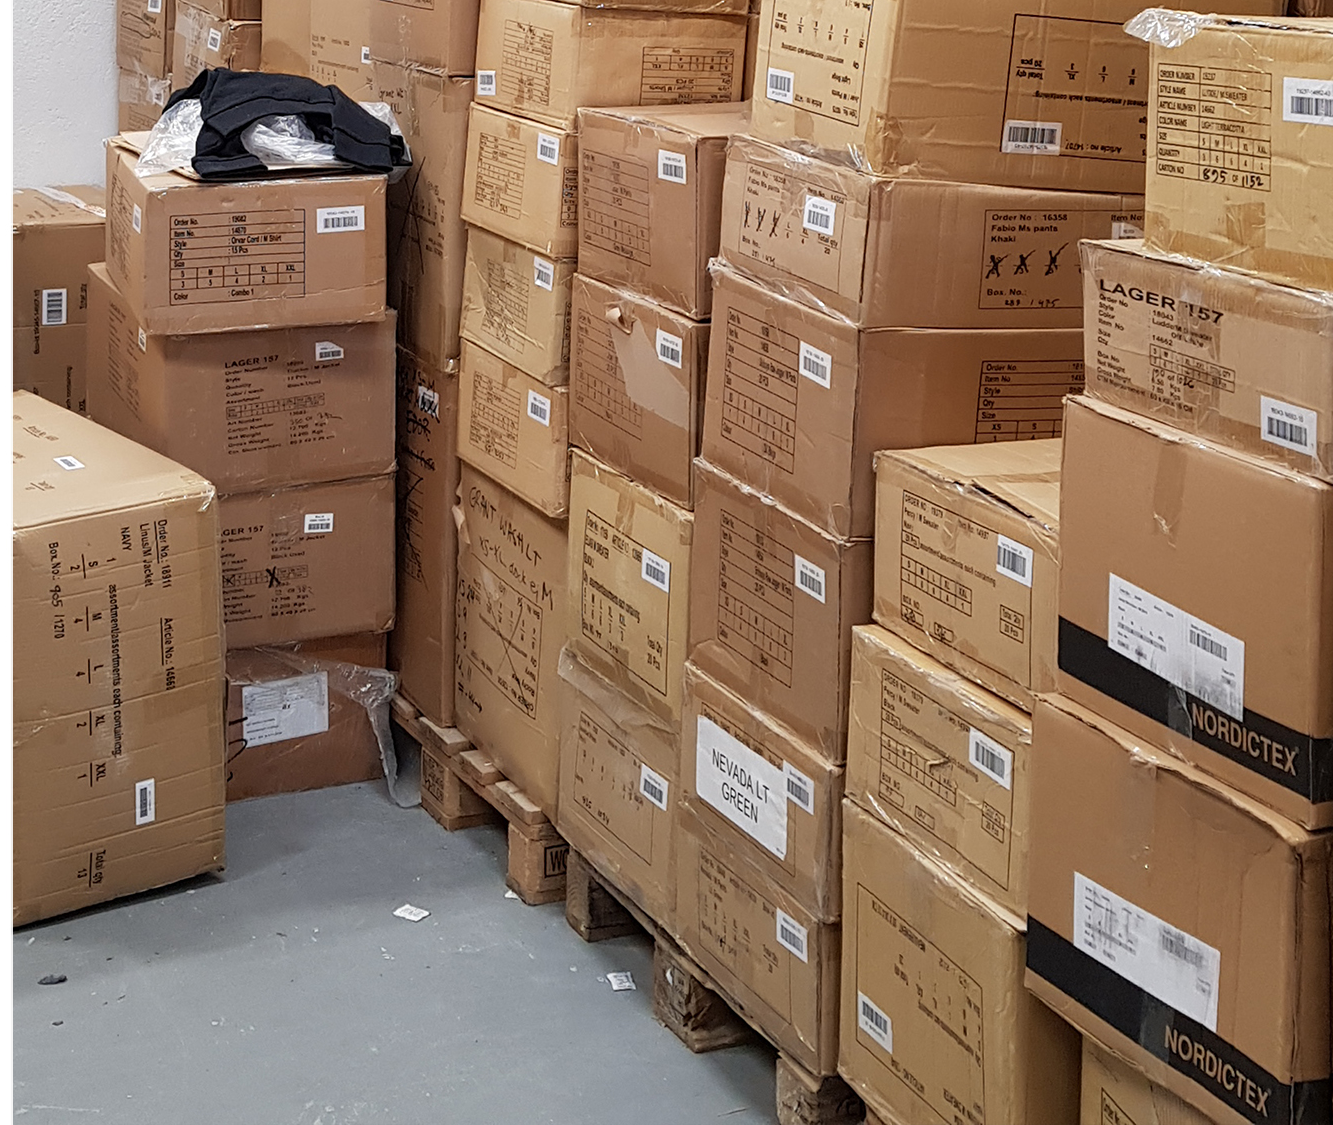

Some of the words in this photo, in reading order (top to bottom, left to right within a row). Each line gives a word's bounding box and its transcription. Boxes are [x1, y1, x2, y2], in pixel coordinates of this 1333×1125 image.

[1028, 72, 1043, 80] Total
[1160, 69, 1174, 78] ORDER
[1176, 72, 1195, 80] NUMBER
[1160, 85, 1172, 94] STYLE
[1173, 86, 1186, 95] NAME
[1085, 96, 1122, 105] assortments
[1159, 101, 1175, 110] ARTICLE
[1177, 103, 1196, 111] NUMBER
[1159, 116, 1174, 125] COLOR
[1174, 118, 1187, 127] NAME
[1159, 132, 1167, 140] SIZE
[1159, 148, 1180, 157] QUANTITY
[1159, 164, 1176, 173] CARTON
[174, 218, 189, 226] Order
[991, 224, 1016, 232] Fabio
[174, 240, 187, 250] Style
[991, 235, 1016, 243] Khaki
[174, 250, 183, 260] Qty
[174, 293, 188, 301] Color
[231, 288, 250, 296] Combo
[1099, 294, 1117, 304] Order
[1119, 299, 1128, 307] No
[1099, 302, 1114, 312] Style
[1100, 279, 1176, 312] LAGER
[1185, 303, 1224, 323] 157
[1098, 310, 1115, 320] Color
[1099, 318, 1112, 327] Item
[1115, 323, 1124, 331] No
[1098, 328, 1111, 338] Size
[1098, 336, 1108, 346] Qty
[224, 357, 261, 368] LAGER
[263, 355, 279, 363] 157
[1098, 350, 1109, 360] Box
[1111, 355, 1120, 363] No
[1107, 362, 1125, 374] Weight
[984, 387, 1001, 397] Style
[983, 399, 995, 409] Qty
[158, 519, 167, 544] Order
[121, 526, 132, 551] NAVY
[526, 543, 542, 567] LT
[88, 560, 98, 568] S
[143, 559, 153, 588] Jacket
[161, 564, 172, 588] 18911
[50, 585, 63, 608] 905
[542, 582, 553, 611] M
[92, 612, 102, 621] M
[108, 584, 121, 687] assortment/assortments
[164, 618, 174, 645] Article
[112, 688, 122, 709] each
[95, 715, 106, 727] XL
[1192, 703, 1297, 776] NORDICTEX
[95, 763, 106, 782] XXL
[712, 748, 754, 795] NEVADA
[756, 780, 770, 803] LT
[721, 782, 758, 823] GREEN
[95, 849, 106, 871] Total
[77, 868, 87, 879] 13
[1165, 1025, 1269, 1117] NORDICTEX
